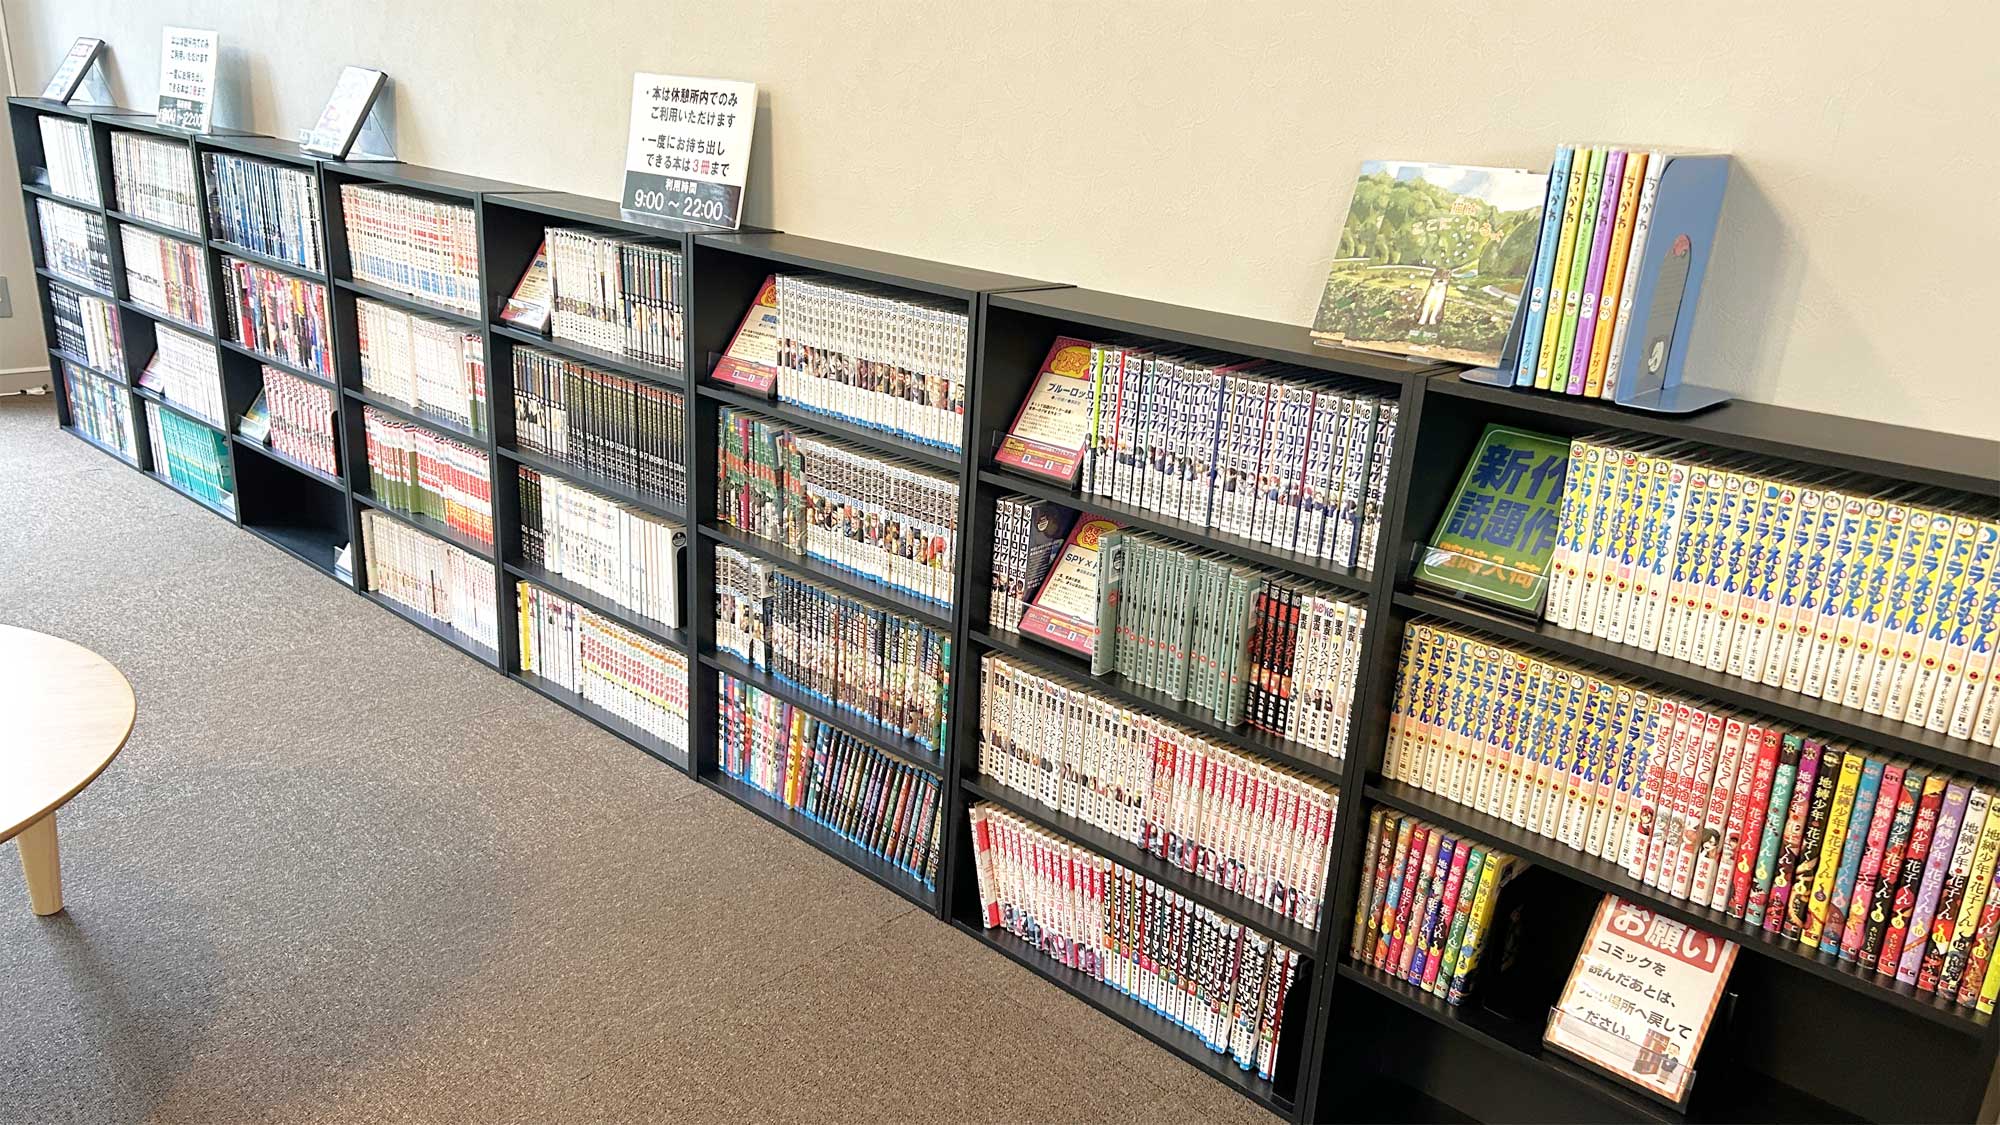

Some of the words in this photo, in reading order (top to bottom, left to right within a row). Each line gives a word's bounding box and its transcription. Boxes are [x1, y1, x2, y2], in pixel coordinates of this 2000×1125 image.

[651, 106, 736, 128] ご利用いただけます
[647, 153, 730, 177] できる本は3冊まで
[665, 179, 697, 195] 利用時間
[1548, 170, 1564, 222] ちいかわ
[1565, 170, 1582, 223] ちいかわ
[1583, 170, 1600, 224] ちいかわ
[1600, 172, 1616, 226] ちいかわ
[1617, 175, 1635, 229] ちいかわ
[1638, 176, 1657, 231] ちいかわ
[634, 189, 664, 211] 9:00
[683, 197, 723, 221] 22:00
[1048, 383, 1088, 400] ブルーロッ
[1447, 490, 1560, 556] 話題作
[1556, 459, 1584, 546] ドラえもん
[1570, 464, 1597, 552] ドラえもん
[1589, 466, 1617, 556] ドラえもん
[1607, 468, 1635, 558] ドラえもん
[1620, 474, 1648, 565] ドラえもん
[1638, 477, 1666, 568] ドラえもん
[1652, 484, 1681, 575] ドラえもん
[1672, 490, 1703, 583] ドラえもん
[1688, 491, 1720, 584] ドラえもん
[1706, 492, 1738, 587] ドラえもん
[1723, 499, 1757, 593] ドラえもん
[1743, 502, 1776, 597] ドラえもん
[1759, 506, 1792, 601] ドラえもん
[1780, 510, 1816, 606] ドラえもん
[1800, 512, 1838, 609] ドラえもん
[1822, 518, 1859, 616] ドラえもん
[1842, 519, 1882, 618] ドラえもん
[1862, 524, 1902, 624] ドラえもん
[1885, 530, 1925, 630] ドラえもん
[1906, 534, 1947, 635] ドラえもん
[1928, 539, 1972, 641] ドラえもん
[1950, 544, 1994, 646] ドラえもん
[1407, 642, 1428, 718] ドラえもん
[1419, 647, 1442, 723] ドラえもん
[1434, 651, 1457, 727] ドラえもん
[1460, 659, 1485, 738] ドラえもん
[1488, 667, 1514, 745] ドラえもん
[1501, 672, 1527, 750] ドラえもん
[1515, 676, 1540, 755] ドラえもん
[1540, 685, 1567, 765] ドラえもん
[1555, 689, 1582, 770] ドラえもん
[1571, 694, 1599, 775] ドラえもん
[1583, 700, 1612, 782] ドラえもん
[1600, 702, 1628, 785] ドラえもん
[1617, 708, 1644, 792] ドラえもん
[1646, 726, 1670, 791] はたらく細胞
[1662, 731, 1686, 797] はたらく細胞
[1676, 736, 1700, 802] はたらく細胞
[1691, 741, 1716, 808] はたらく細胞
[1710, 746, 1736, 814] はたらく細胞
[1730, 750, 1756, 820] はたらく細胞
[1598, 940, 1666, 977] コミックを
[1614, 903, 1717, 964] お願い
[1588, 964, 1676, 1008] 読んだあとは、
